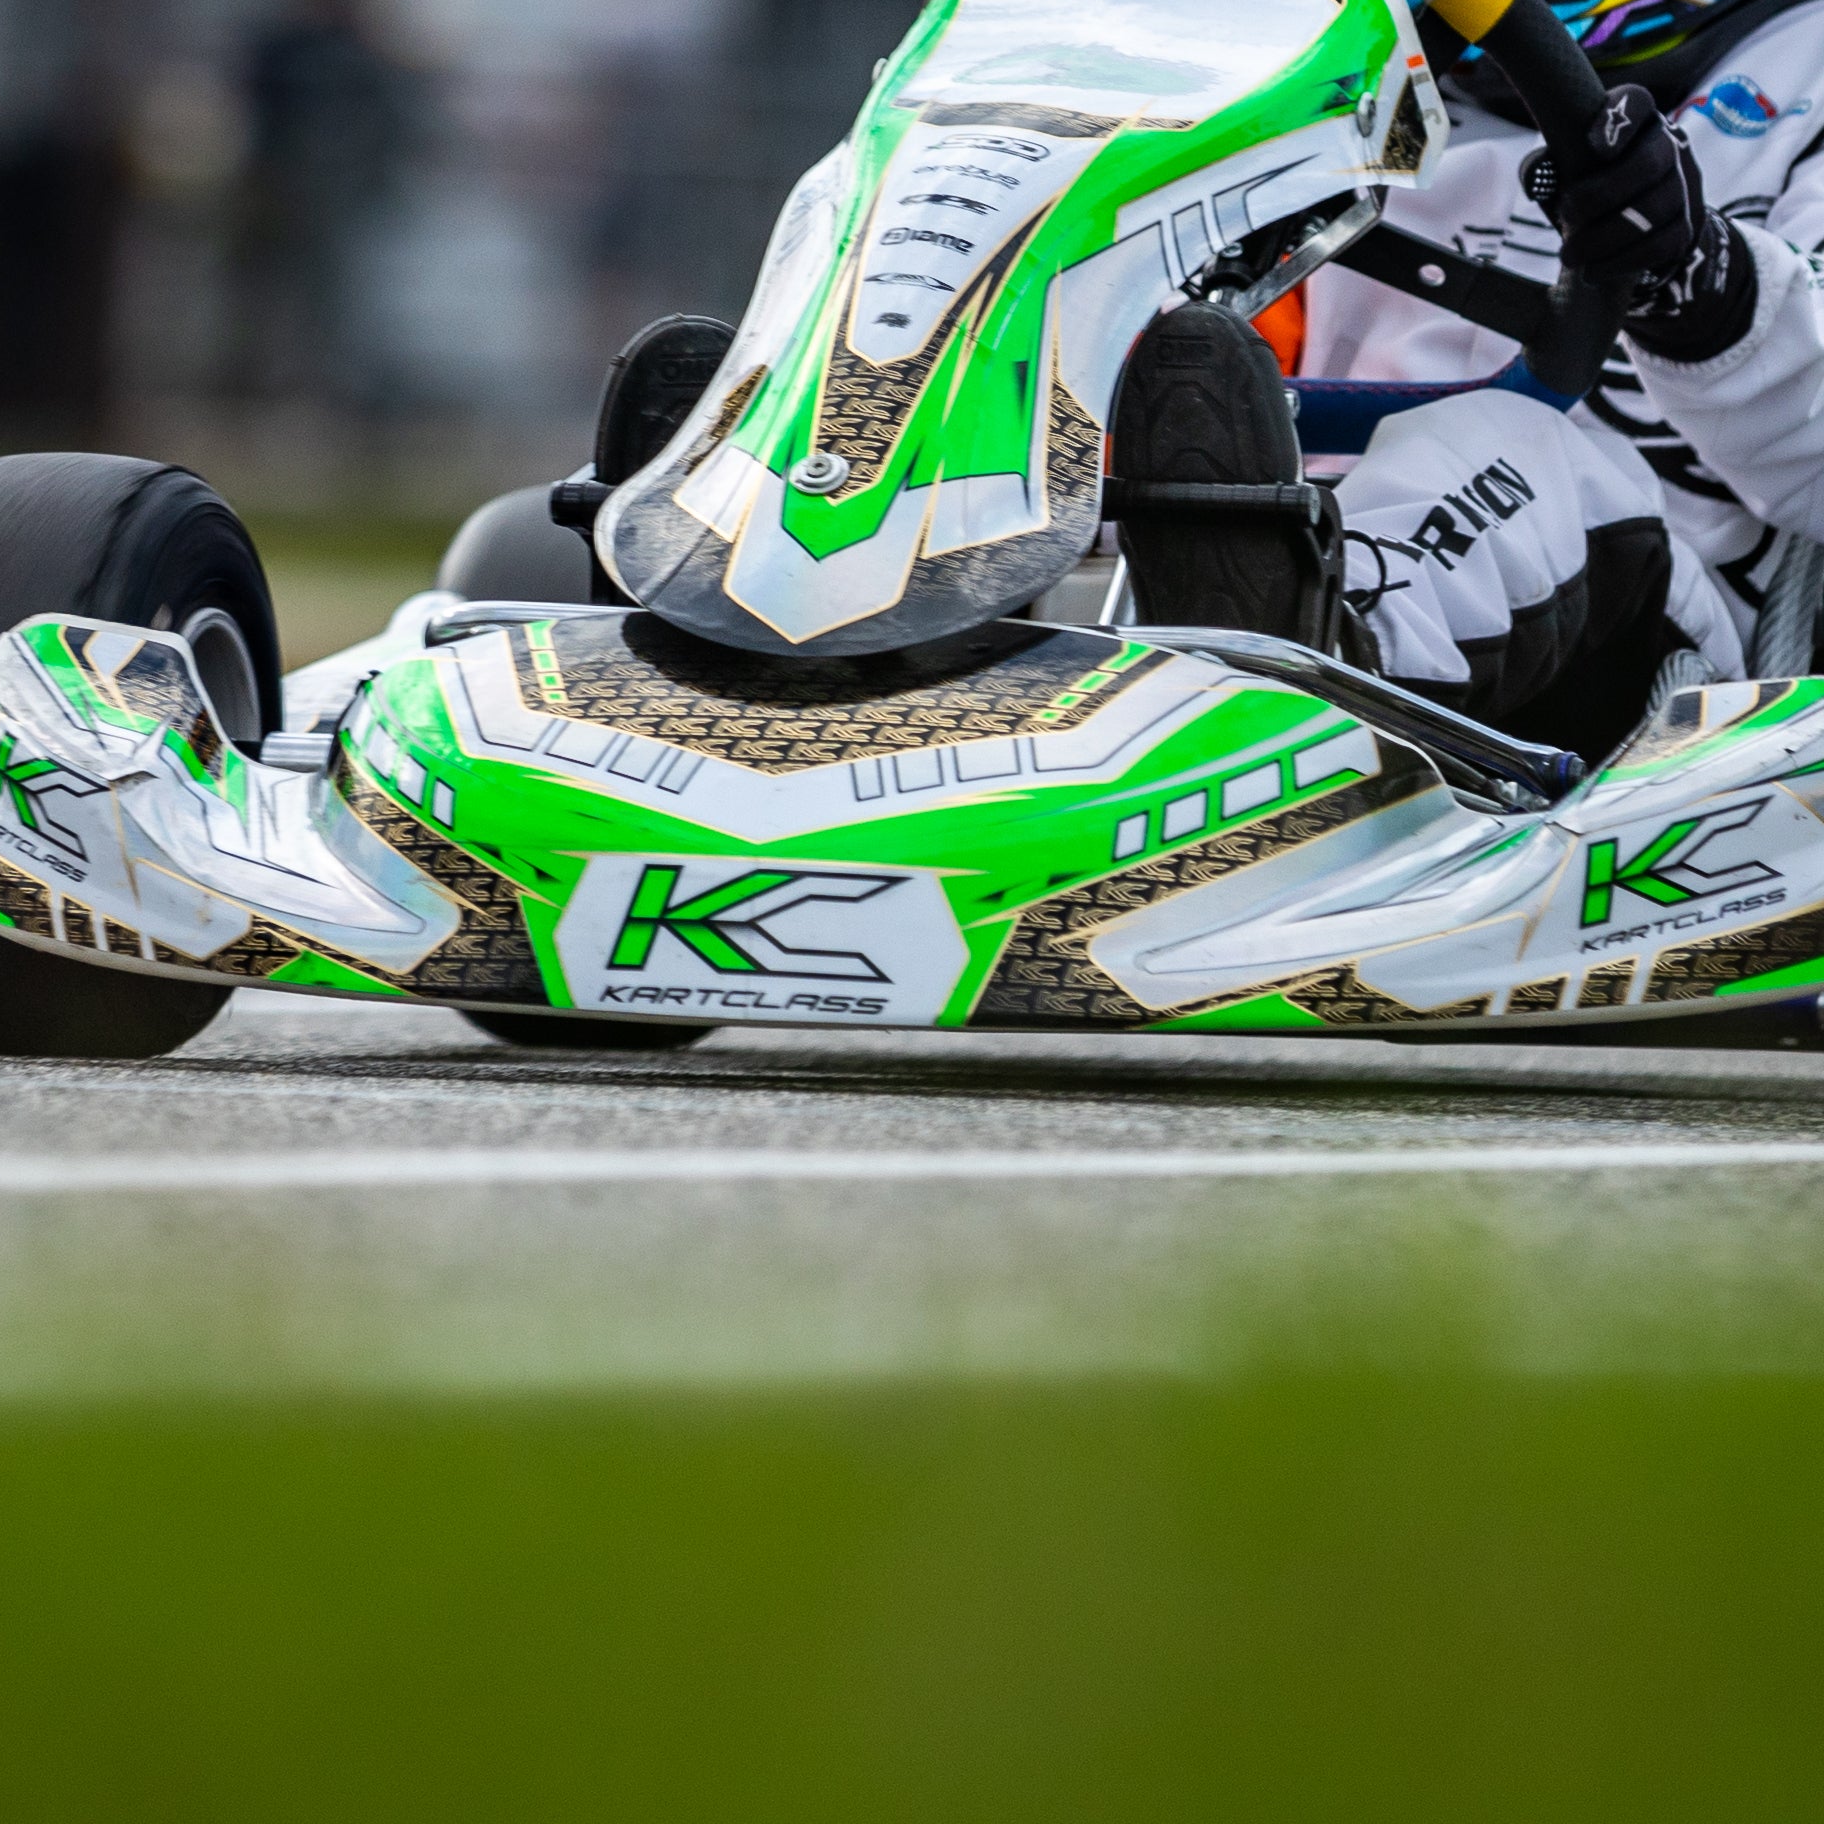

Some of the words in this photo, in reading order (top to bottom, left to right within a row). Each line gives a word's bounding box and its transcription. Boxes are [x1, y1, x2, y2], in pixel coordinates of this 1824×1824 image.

[1580, 794, 1786, 929] KC
[605, 863, 915, 984] KC
[1580, 887, 1788, 954] KARTCLASS
[599, 985, 889, 1016] KARTCLASS
